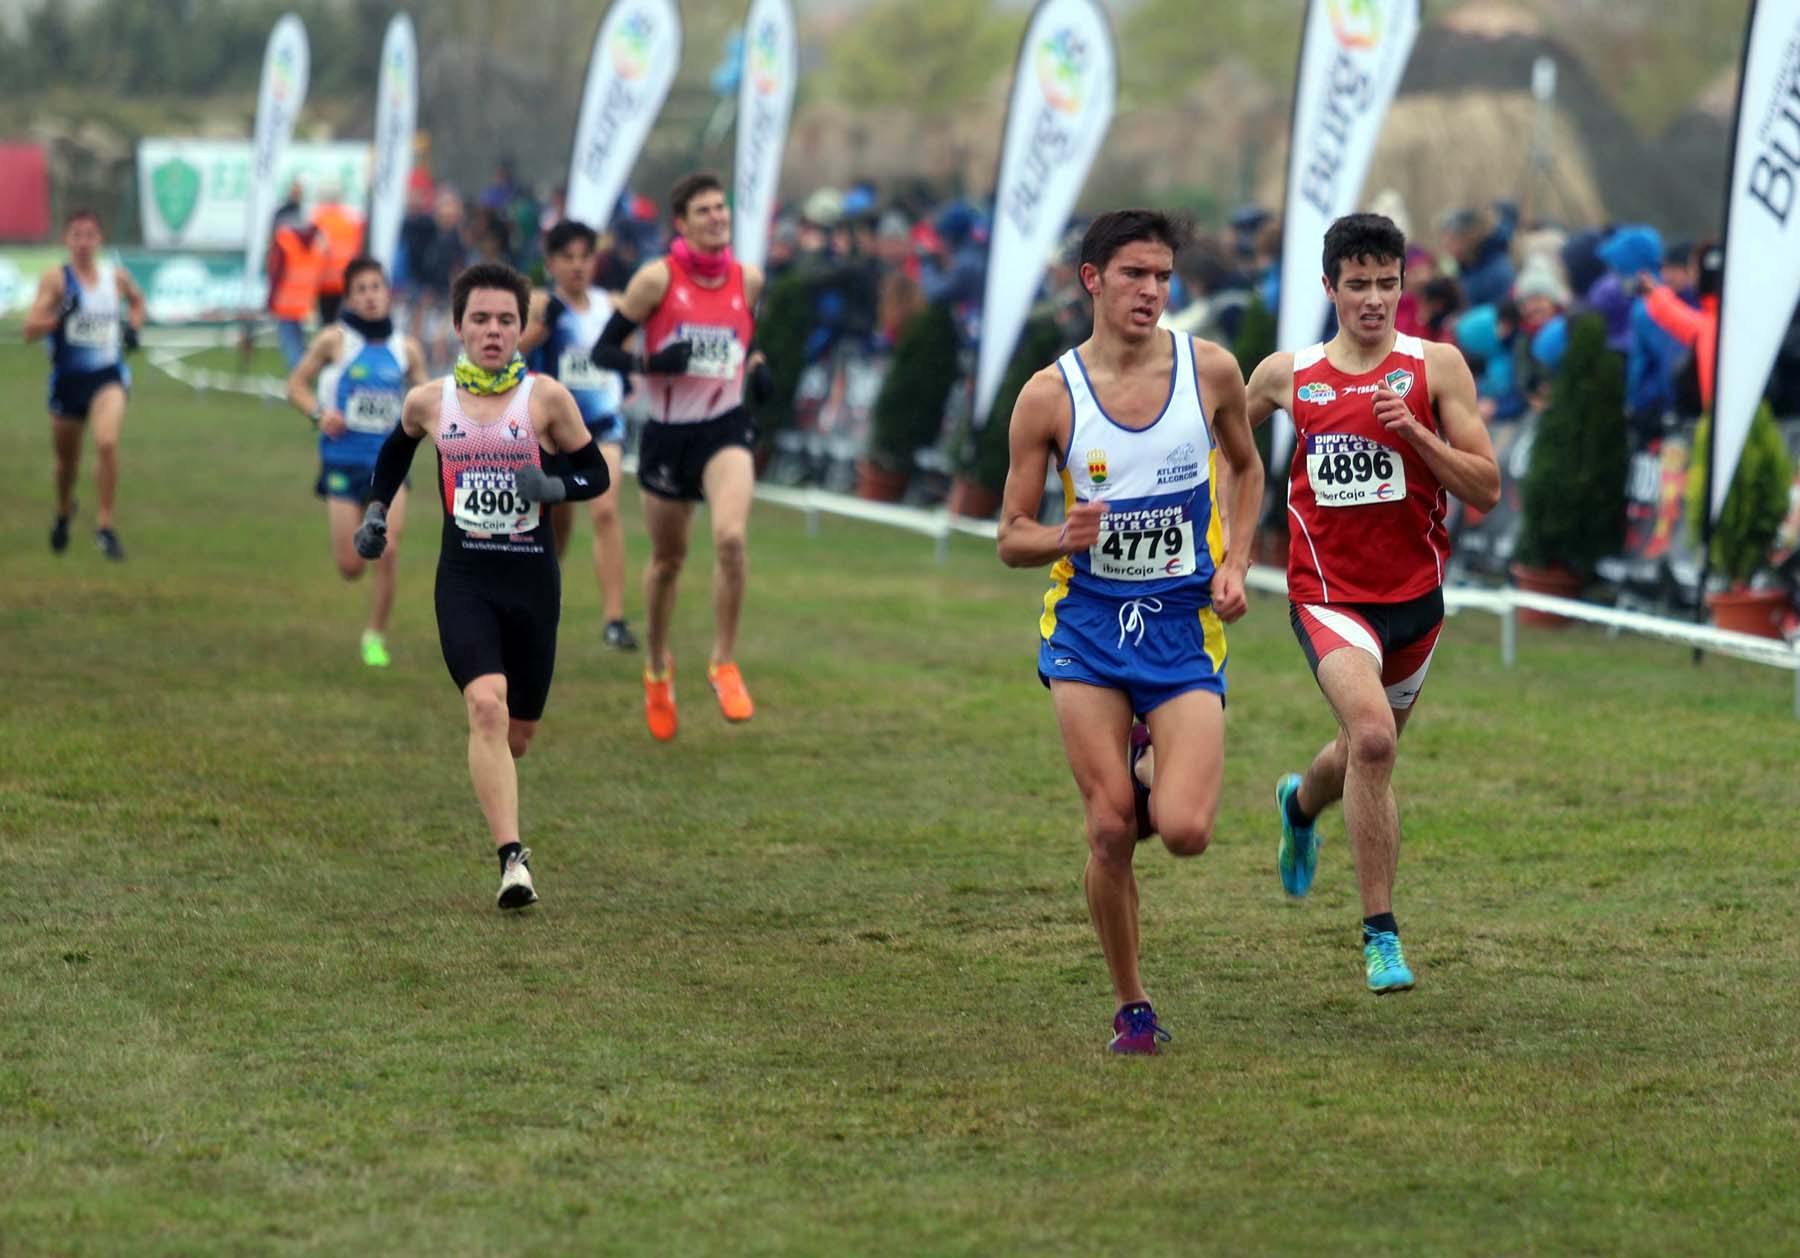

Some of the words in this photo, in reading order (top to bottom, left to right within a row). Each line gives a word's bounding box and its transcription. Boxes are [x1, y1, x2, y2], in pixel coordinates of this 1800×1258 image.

[1157, 462, 1198, 476] ATLETISMO
[1318, 452, 1393, 485] 4896
[464, 491, 531, 515] 4903
[1101, 505, 1182, 521] DIPUTACIÓN
[1101, 515, 1184, 531] BURGOS
[1102, 527, 1183, 560] 4779
[1103, 563, 1154, 577] iberCaja
